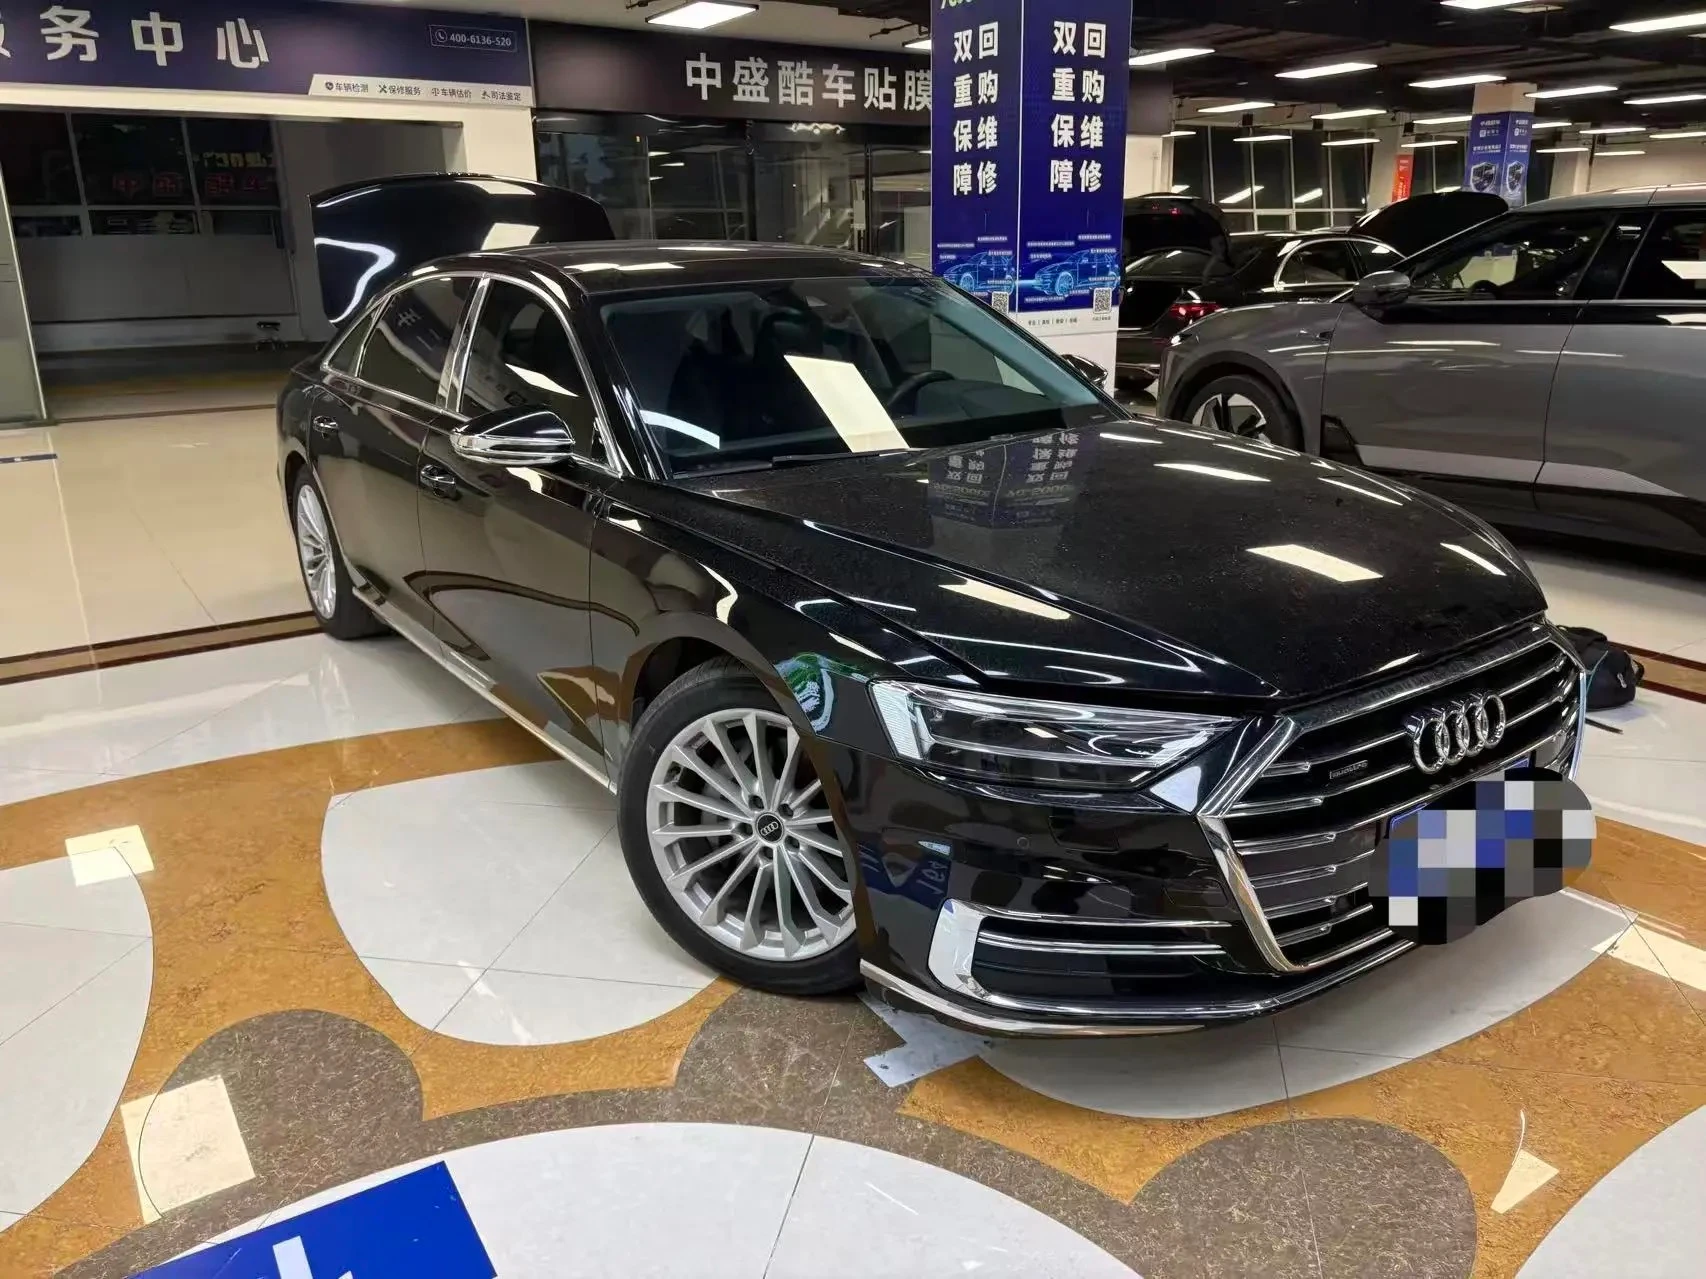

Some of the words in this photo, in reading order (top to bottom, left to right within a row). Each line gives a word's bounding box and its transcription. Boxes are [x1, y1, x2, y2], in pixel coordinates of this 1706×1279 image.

[0, 5, 269, 69] 务中心
[335, 82, 369, 93] 车辆检测
[388, 85, 421, 96] 保修服务
[440, 88, 472, 99] 车辆估价
[491, 91, 522, 101] 司法鉴定
[449, 33, 512, 47] 400-6136-520
[685, 52, 932, 112] 中盛酷车贴膜
[953, 29, 973, 196] 双重保障
[977, 21, 999, 194] 回购维修
[1050, 20, 1077, 193] 双重保障
[1079, 22, 1107, 193] 回购维修
